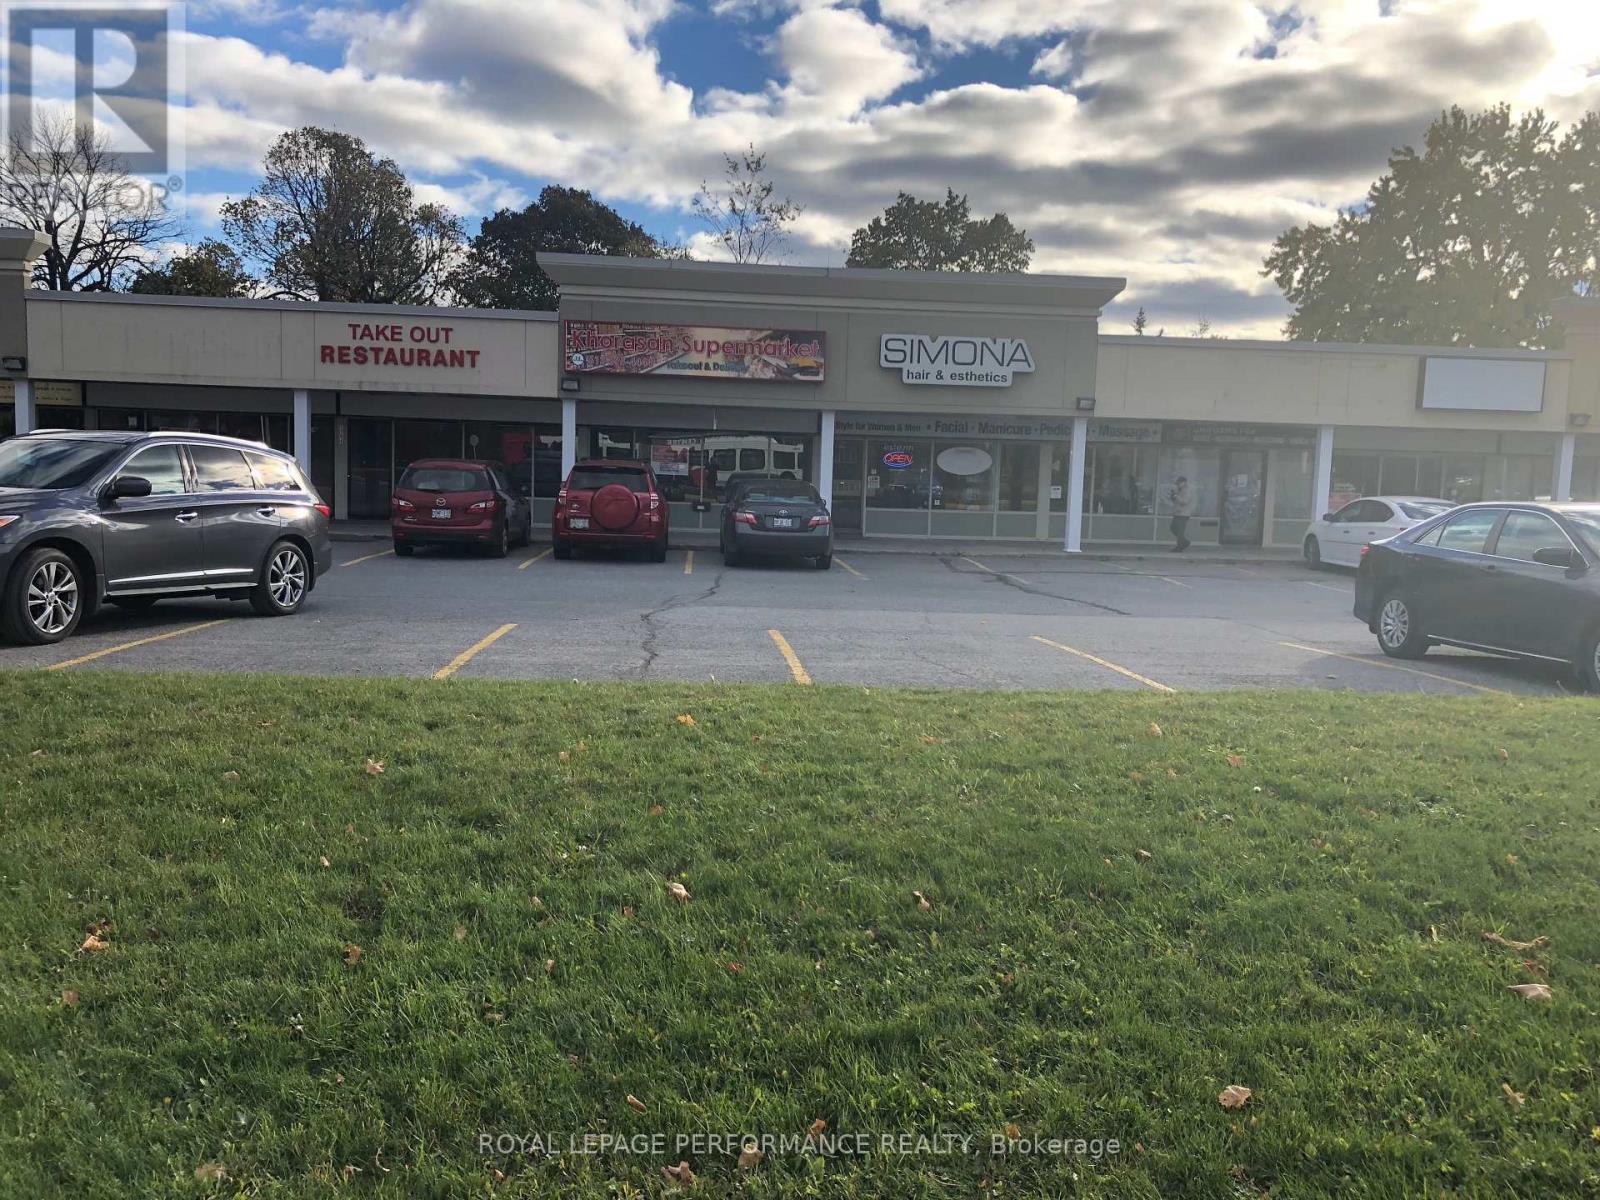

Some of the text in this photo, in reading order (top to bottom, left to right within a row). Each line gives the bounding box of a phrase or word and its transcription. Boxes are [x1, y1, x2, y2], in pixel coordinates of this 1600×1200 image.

[348, 323, 453, 344] TAKE OUT
[571, 329, 821, 359] Khorasan Supermarket
[320, 345, 481, 368] RESTAURANT
[883, 337, 1032, 368] SIMONA
[906, 369, 1008, 383] hair & esthetics
[935, 420, 969, 434] Facial
[978, 421, 1032, 436] Manicure
[1040, 422, 1073, 436] Pedic
[884, 453, 913, 464] OPEN
